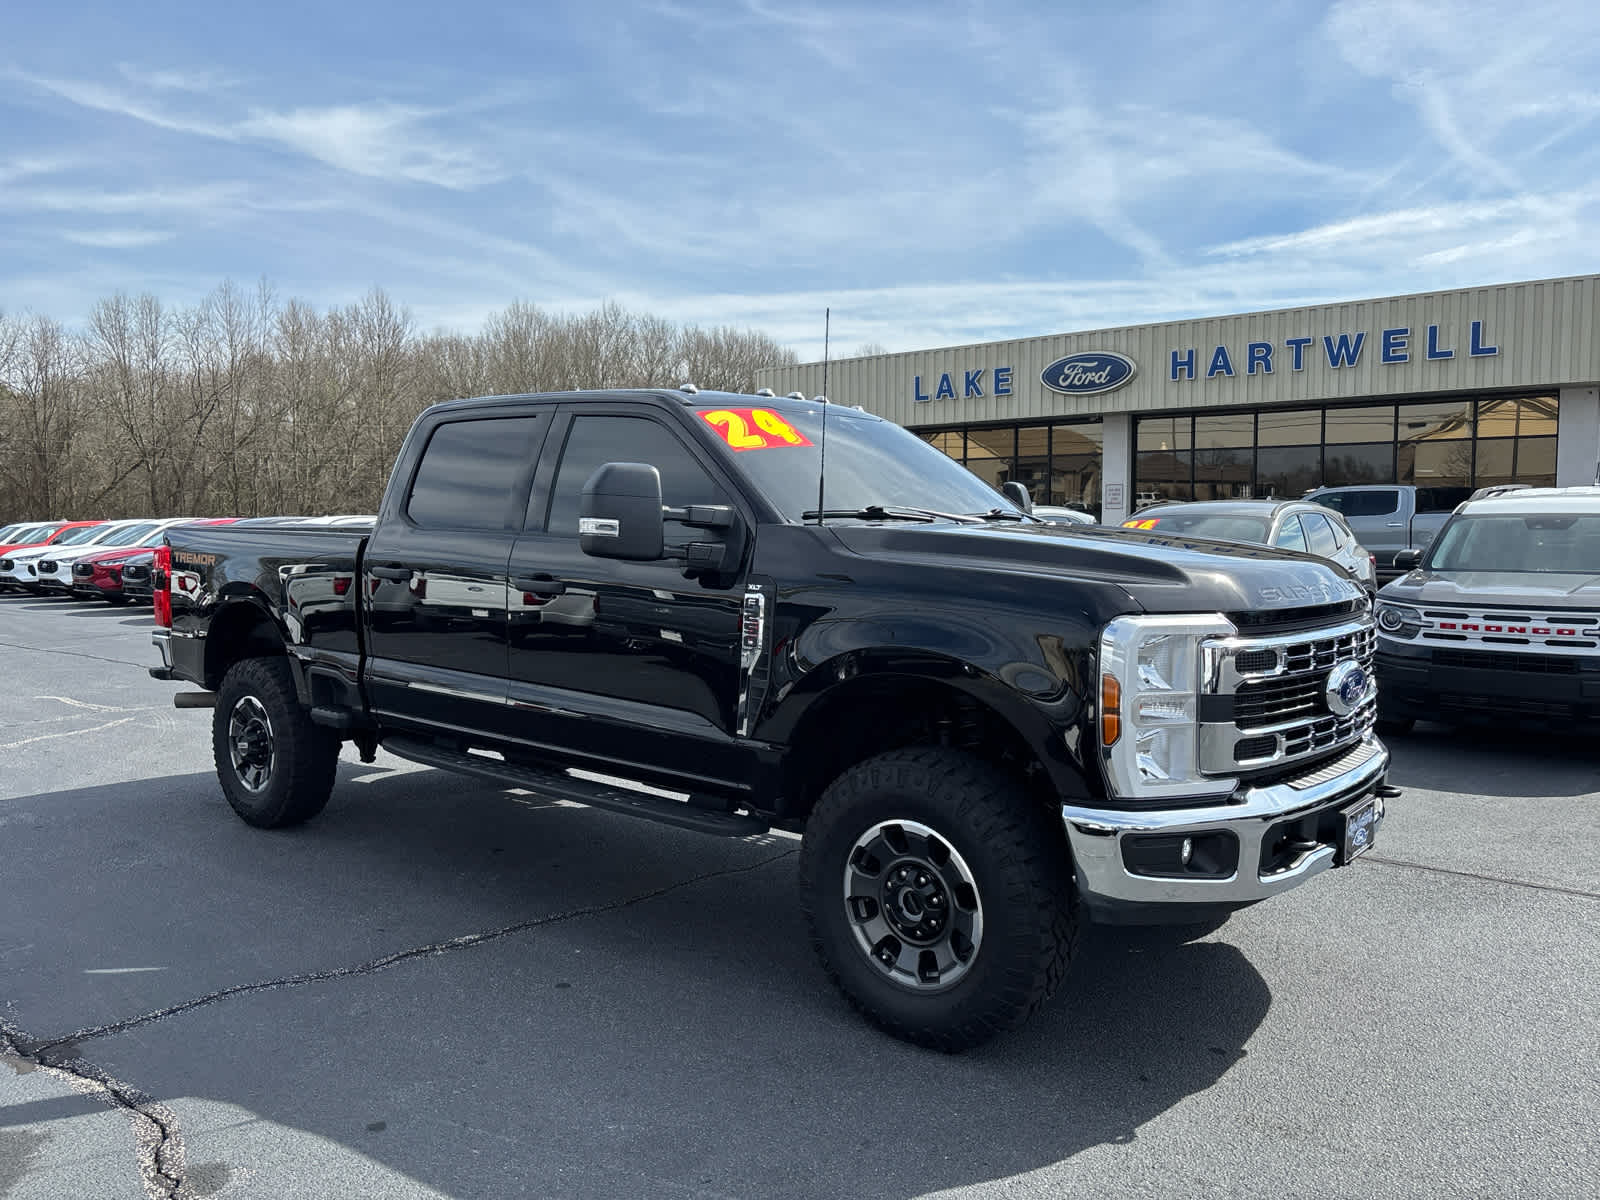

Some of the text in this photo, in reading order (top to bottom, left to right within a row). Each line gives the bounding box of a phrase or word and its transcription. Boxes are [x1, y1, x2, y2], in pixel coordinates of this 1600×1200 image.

[914, 320, 1500, 401] LAKE HARTWELL
[1058, 360, 1112, 388] Ford
[704, 409, 803, 448] 24
[174, 551, 216, 566] TREMOR
[748, 583, 763, 591] XLT
[1439, 622, 1576, 636] BRONCO
